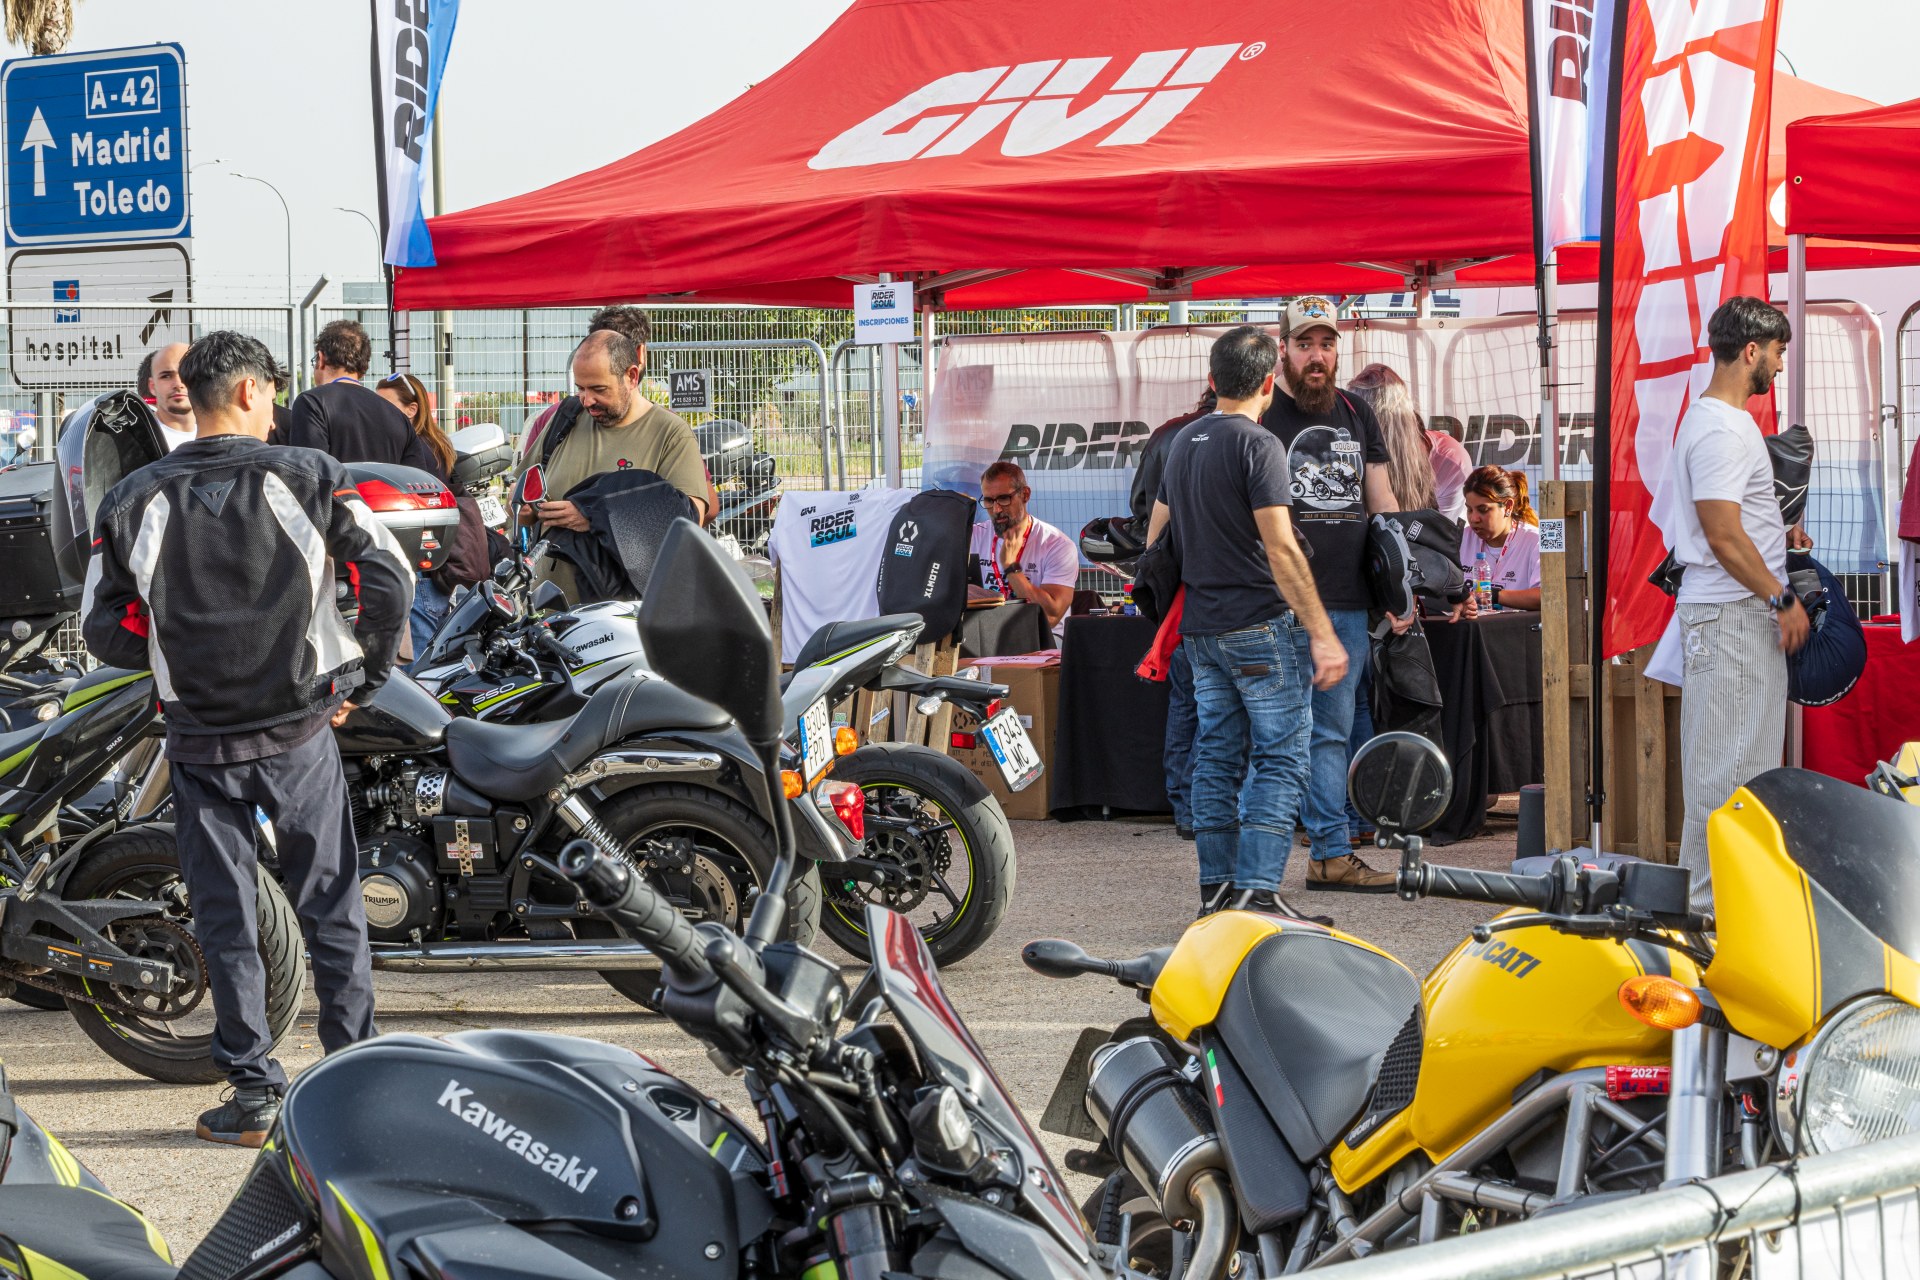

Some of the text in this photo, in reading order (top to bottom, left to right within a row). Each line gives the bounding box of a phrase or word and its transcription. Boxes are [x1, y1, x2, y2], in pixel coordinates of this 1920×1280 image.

[90, 76, 156, 110] A-42
[807, 43, 1242, 170] GIVI
[71, 126, 171, 167] Madrid
[73, 179, 171, 216] Toledo
[871, 291, 894, 300] RIDER
[873, 299, 893, 308] SOUL
[858, 317, 909, 326] INSCRIPCIONES
[25, 333, 124, 367] hospital
[676, 374, 700, 391] AMS
[997, 421, 1151, 470] RIDER
[800, 506, 816, 516] GIVI
[811, 510, 855, 532] RIDER
[815, 524, 854, 545] SOUL
[924, 562, 940, 598] XLMOTO
[472, 683, 515, 704] 650
[807, 701, 827, 740] 9303
[992, 715, 1022, 750] 7343
[106, 736, 123, 752] SHAD
[1005, 743, 1030, 774] LMC
[363, 894, 400, 904] TRIUMPH
[1631, 1068, 1659, 1078] 2027
[437, 1079, 599, 1194] Kawasaki
